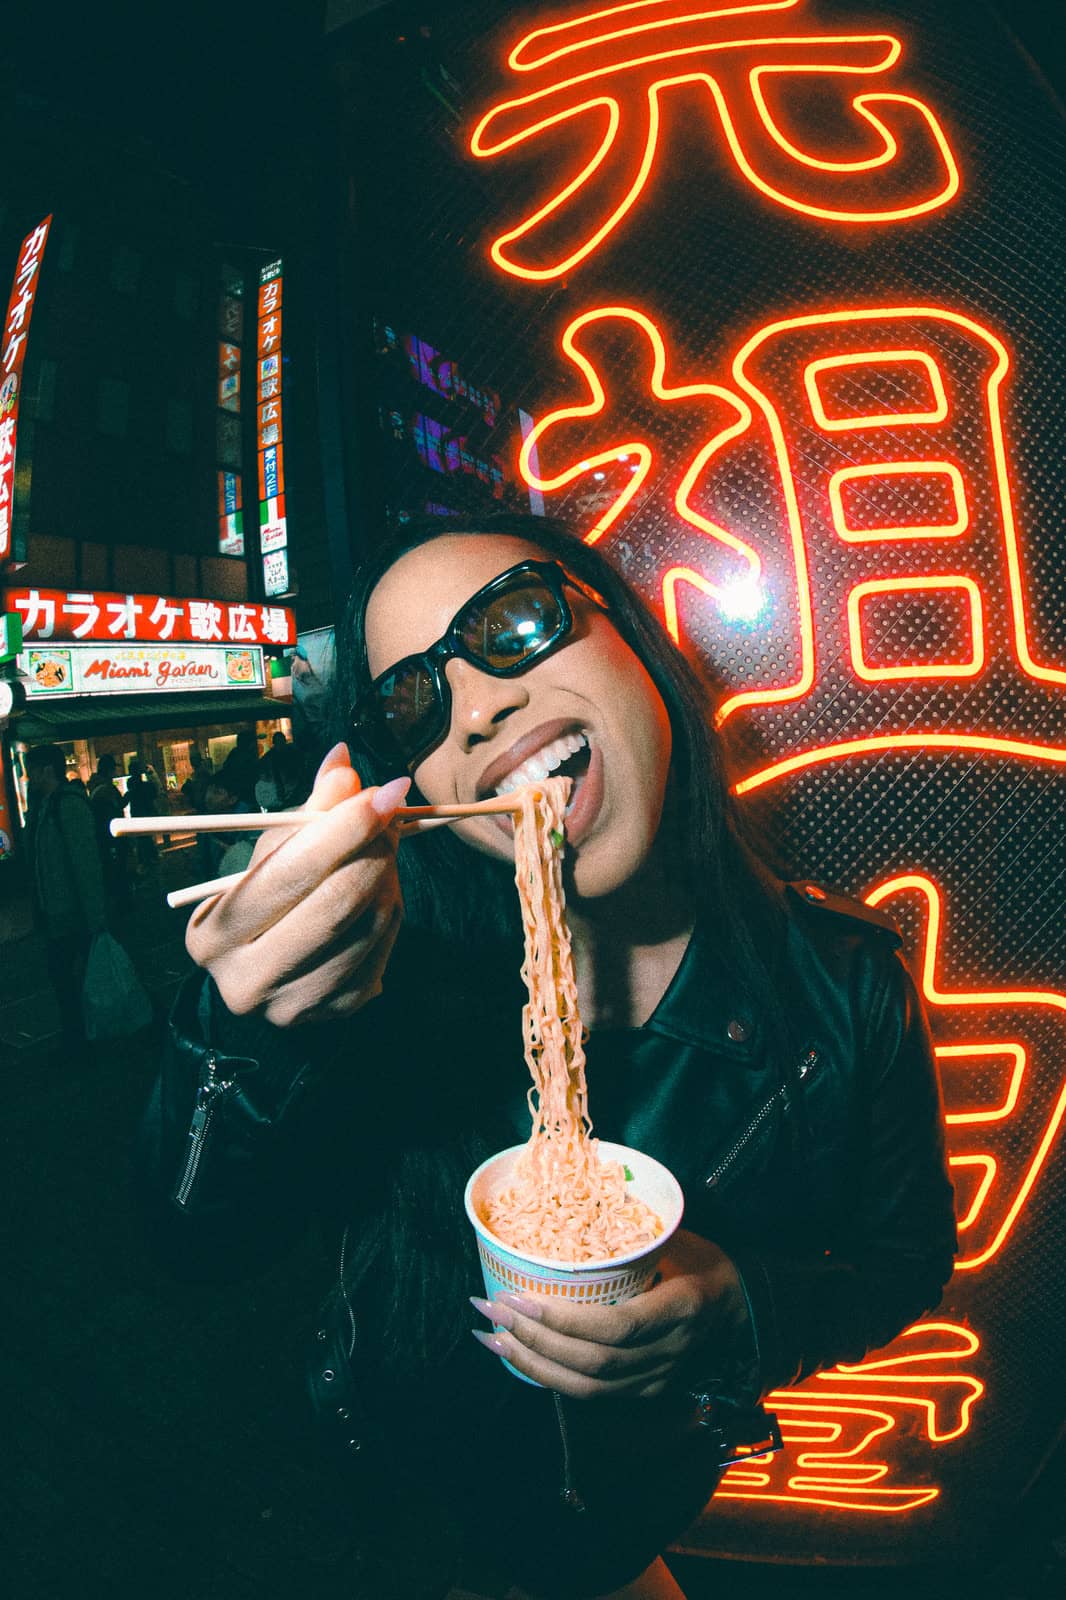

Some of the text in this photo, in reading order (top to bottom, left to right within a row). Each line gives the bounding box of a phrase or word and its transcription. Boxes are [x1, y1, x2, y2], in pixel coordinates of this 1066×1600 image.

[15, 589, 290, 643] カラオケ歌広場
[83, 659, 151, 680] Miami
